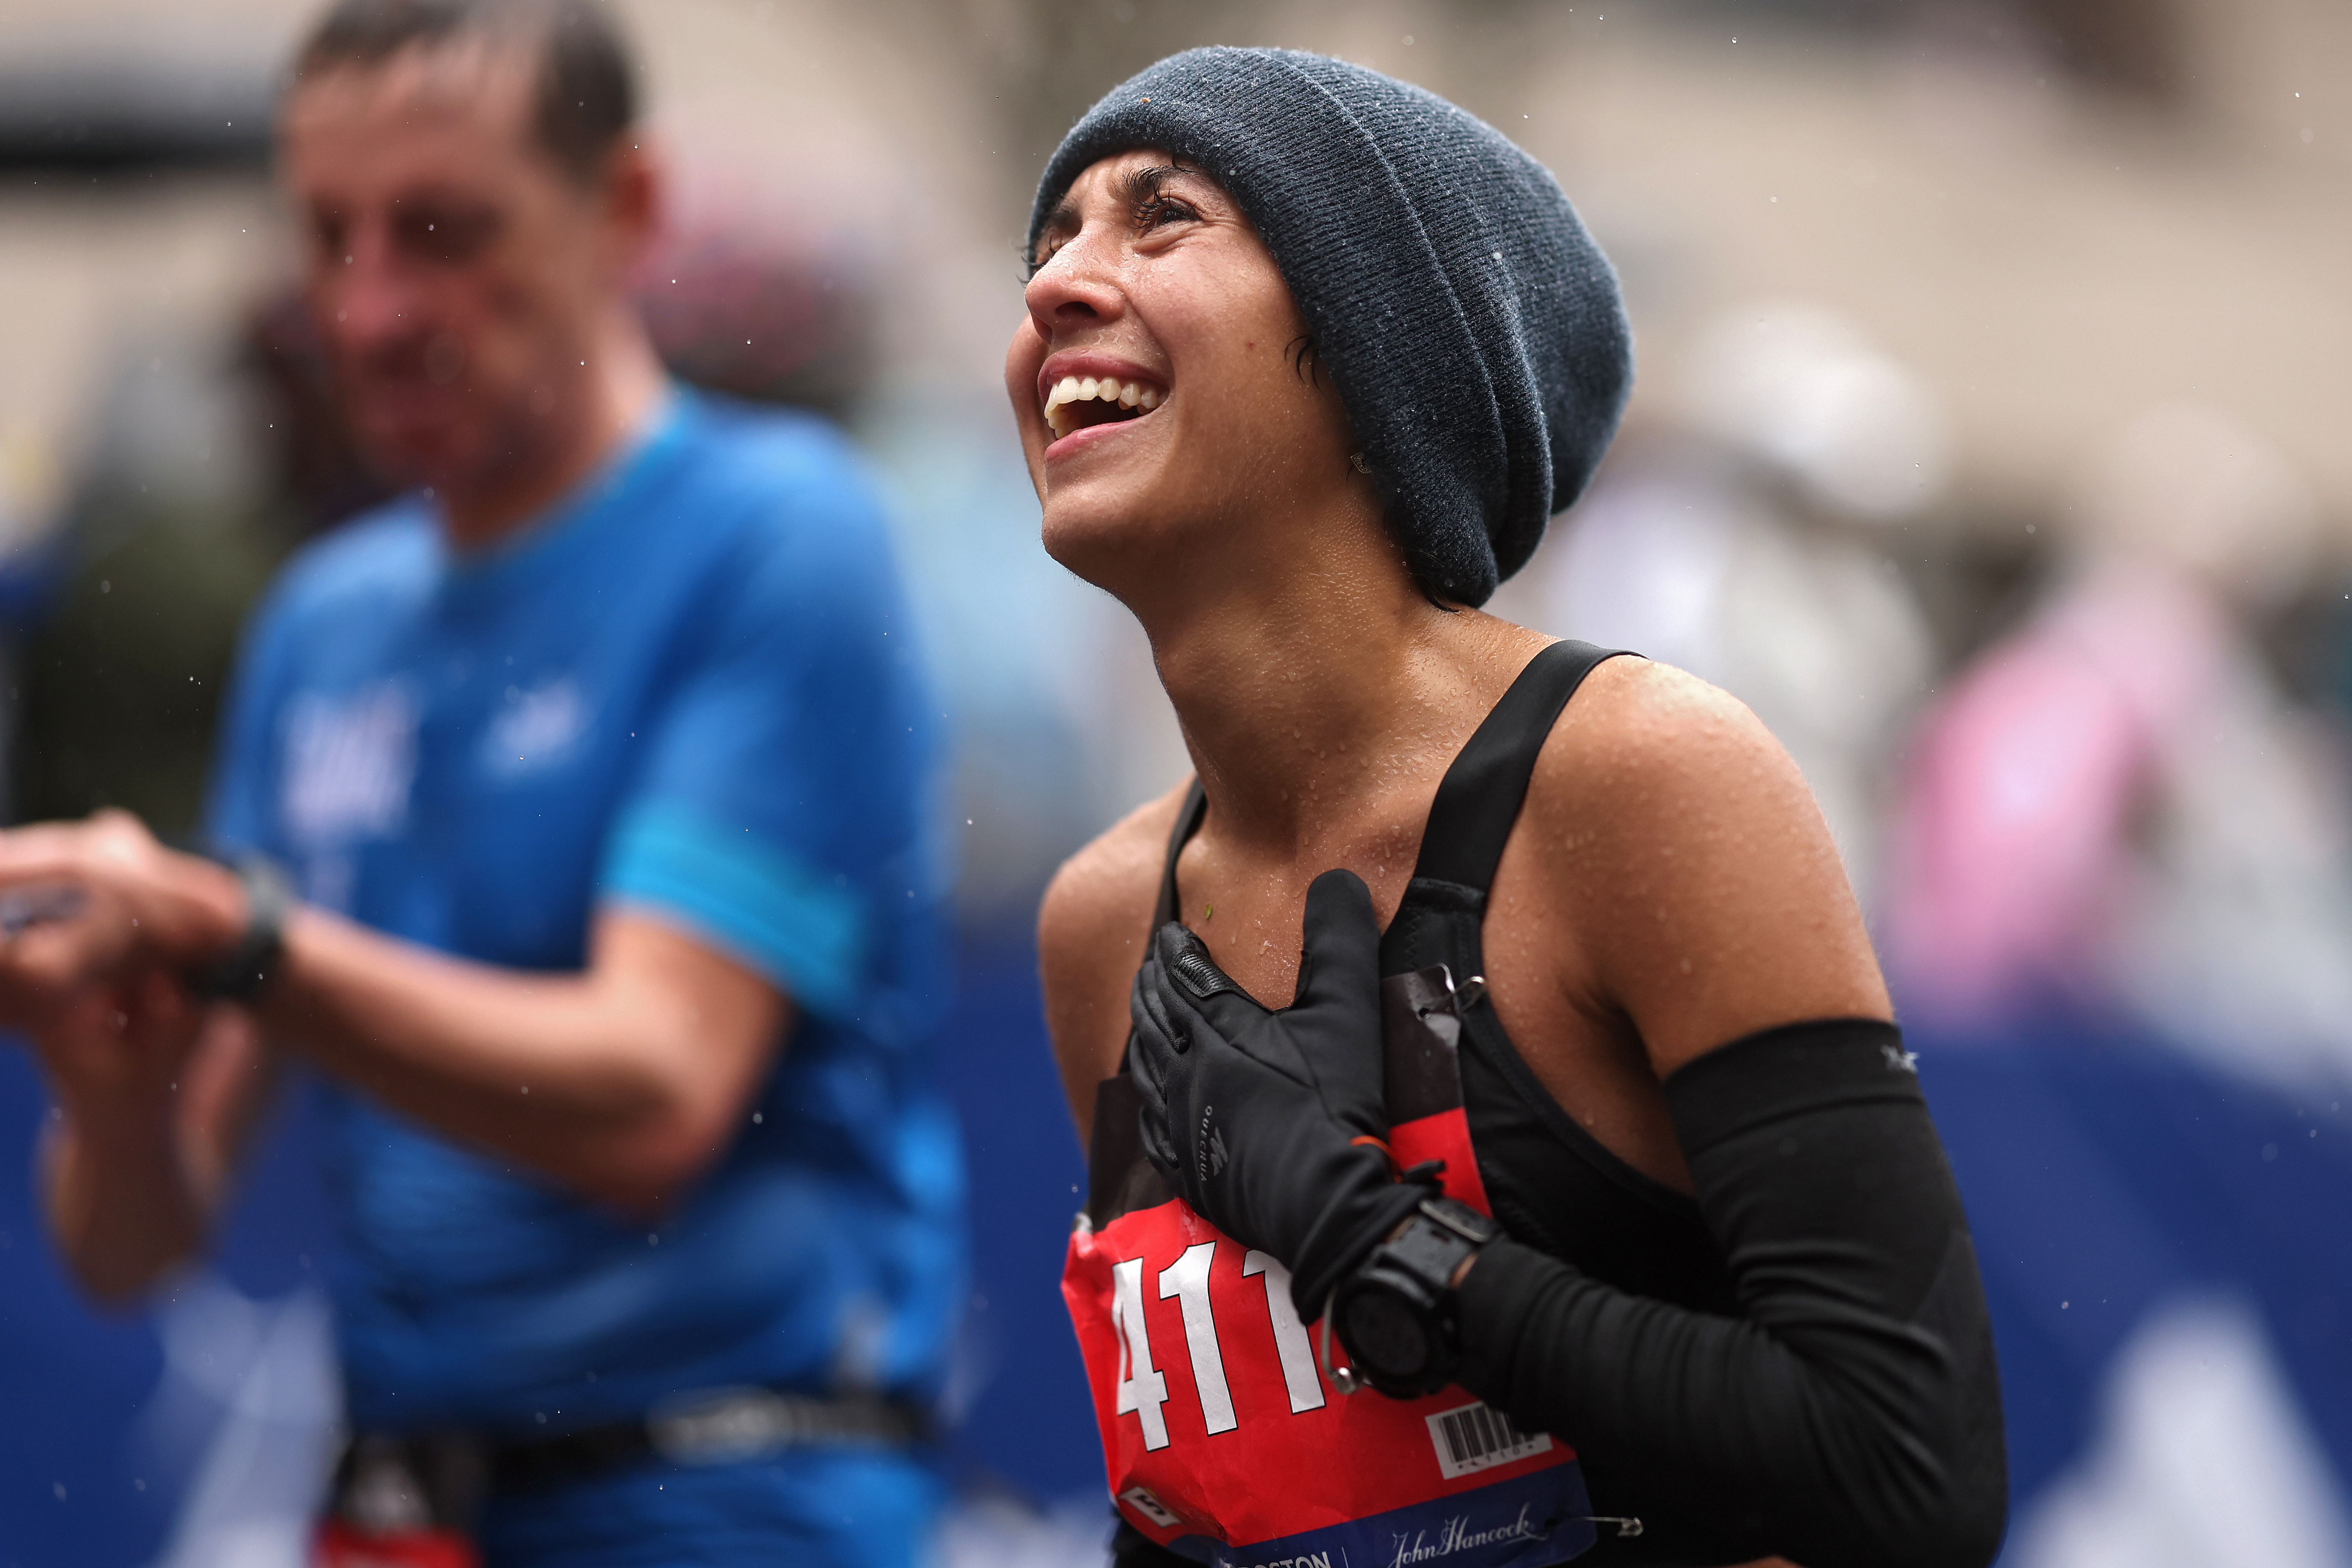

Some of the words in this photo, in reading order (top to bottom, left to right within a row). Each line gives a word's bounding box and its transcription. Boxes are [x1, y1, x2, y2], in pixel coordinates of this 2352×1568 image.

[1388, 1529, 1437, 1568] John
[1436, 1502, 1548, 1556] Hancock
[1238, 1550, 1332, 1568] TON
